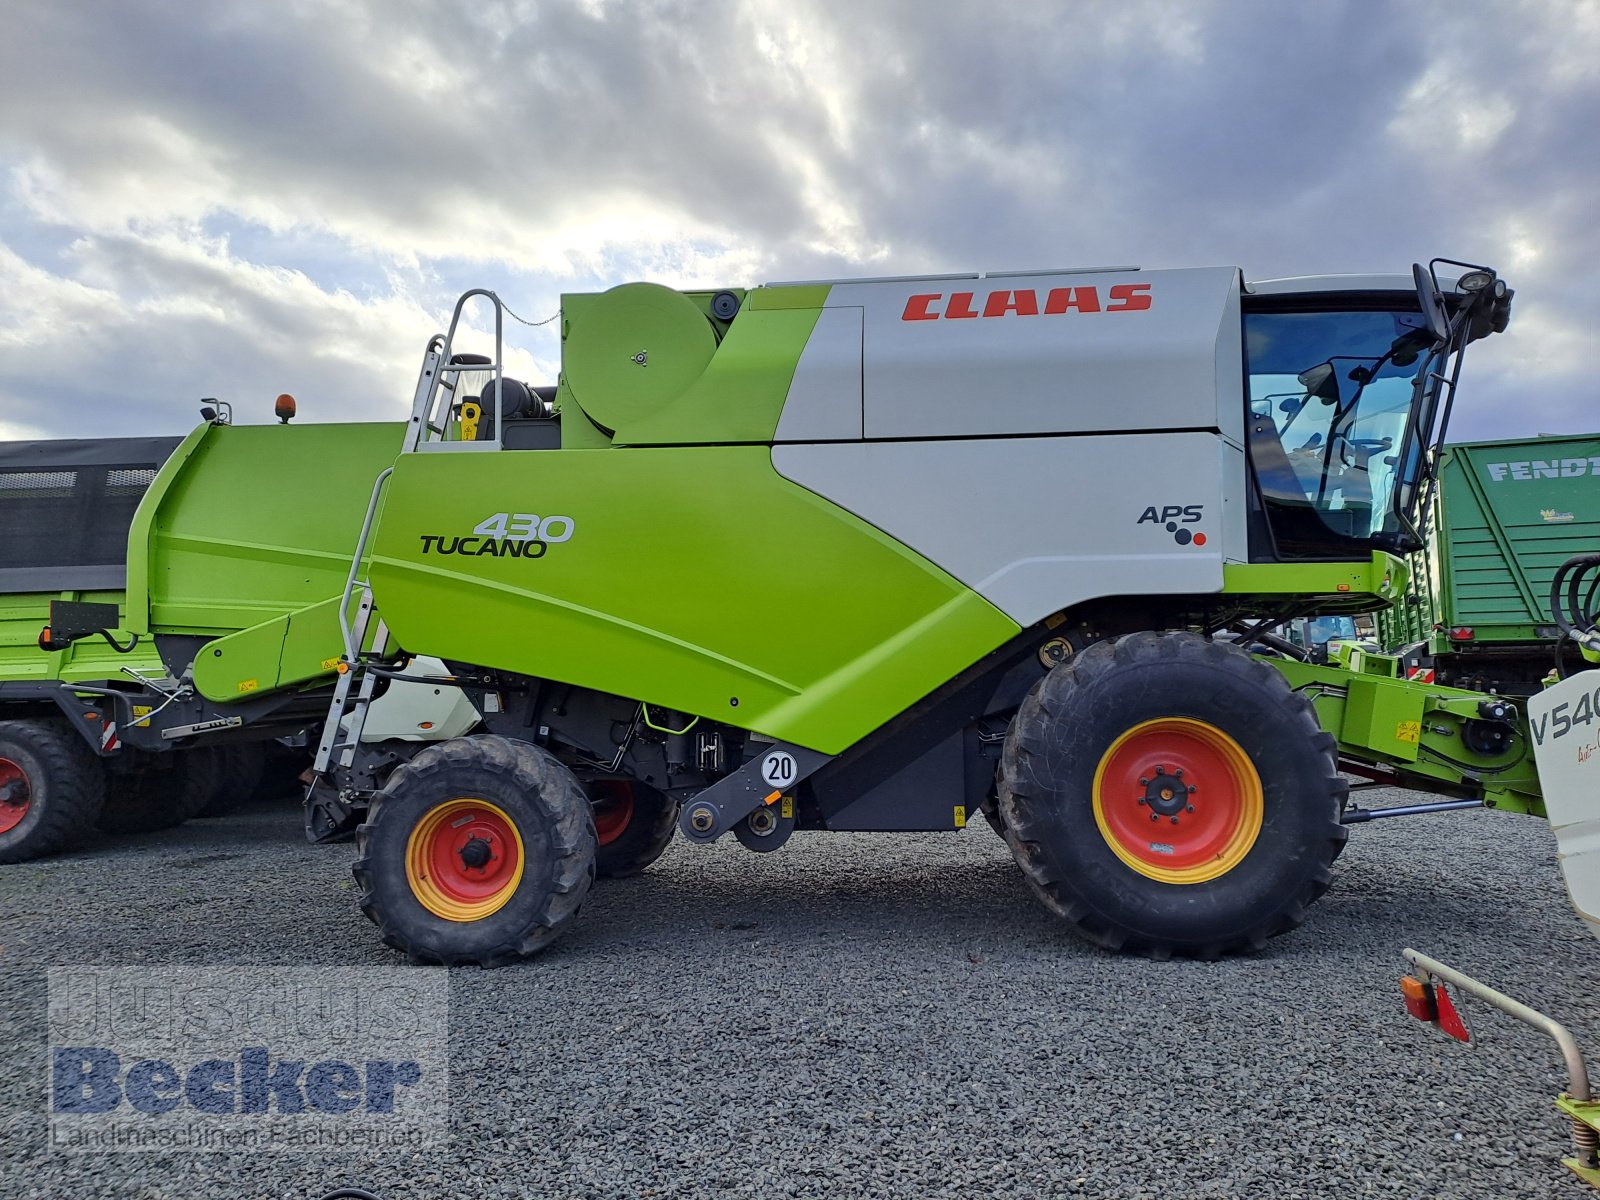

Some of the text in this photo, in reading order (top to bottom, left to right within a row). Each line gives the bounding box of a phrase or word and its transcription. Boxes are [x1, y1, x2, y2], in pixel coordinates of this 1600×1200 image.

[902, 284, 1152, 321] CLAAS
[1137, 505, 1203, 524] APS
[473, 513, 575, 543] 430
[420, 536, 548, 558] TUCANO
[768, 757, 792, 780] 20
